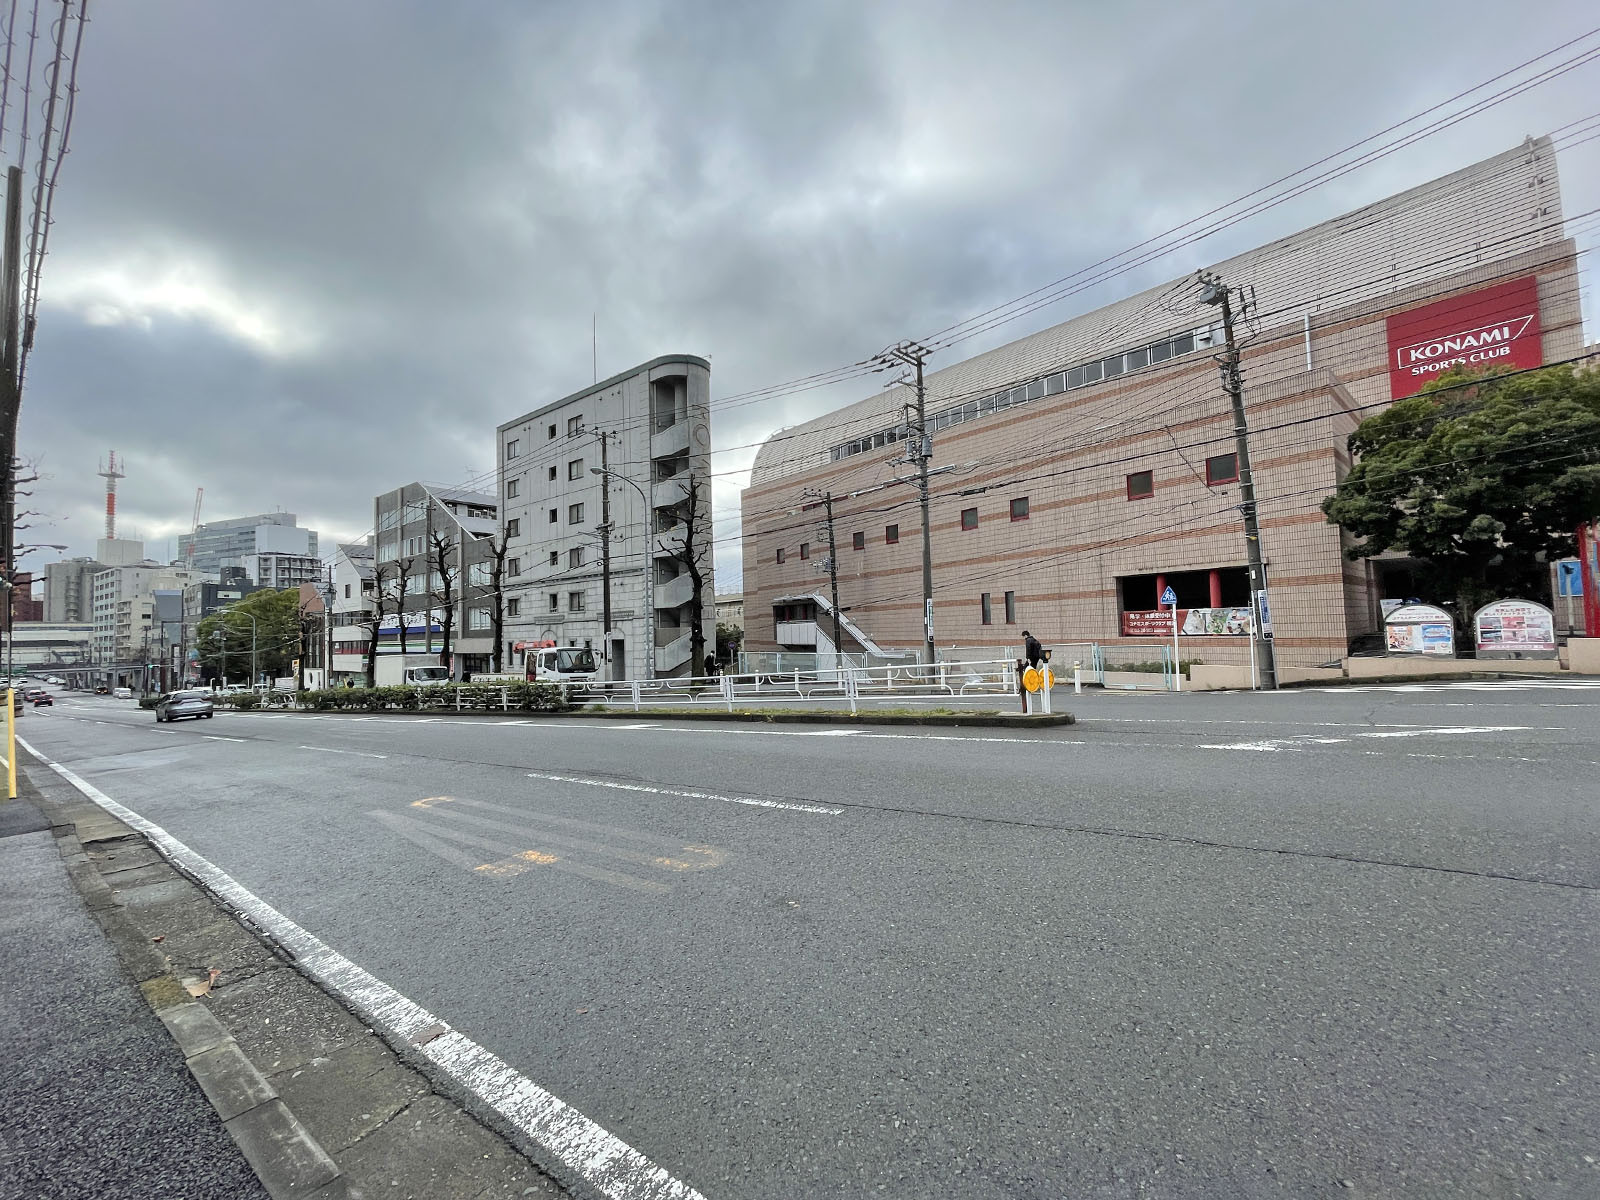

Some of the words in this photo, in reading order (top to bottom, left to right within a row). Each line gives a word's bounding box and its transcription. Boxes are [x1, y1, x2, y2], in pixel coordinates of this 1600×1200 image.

[1410, 326, 1510, 362] KONAMI
[1411, 355, 1467, 376] SPORTS
[1469, 346, 1511, 363] CLUB
